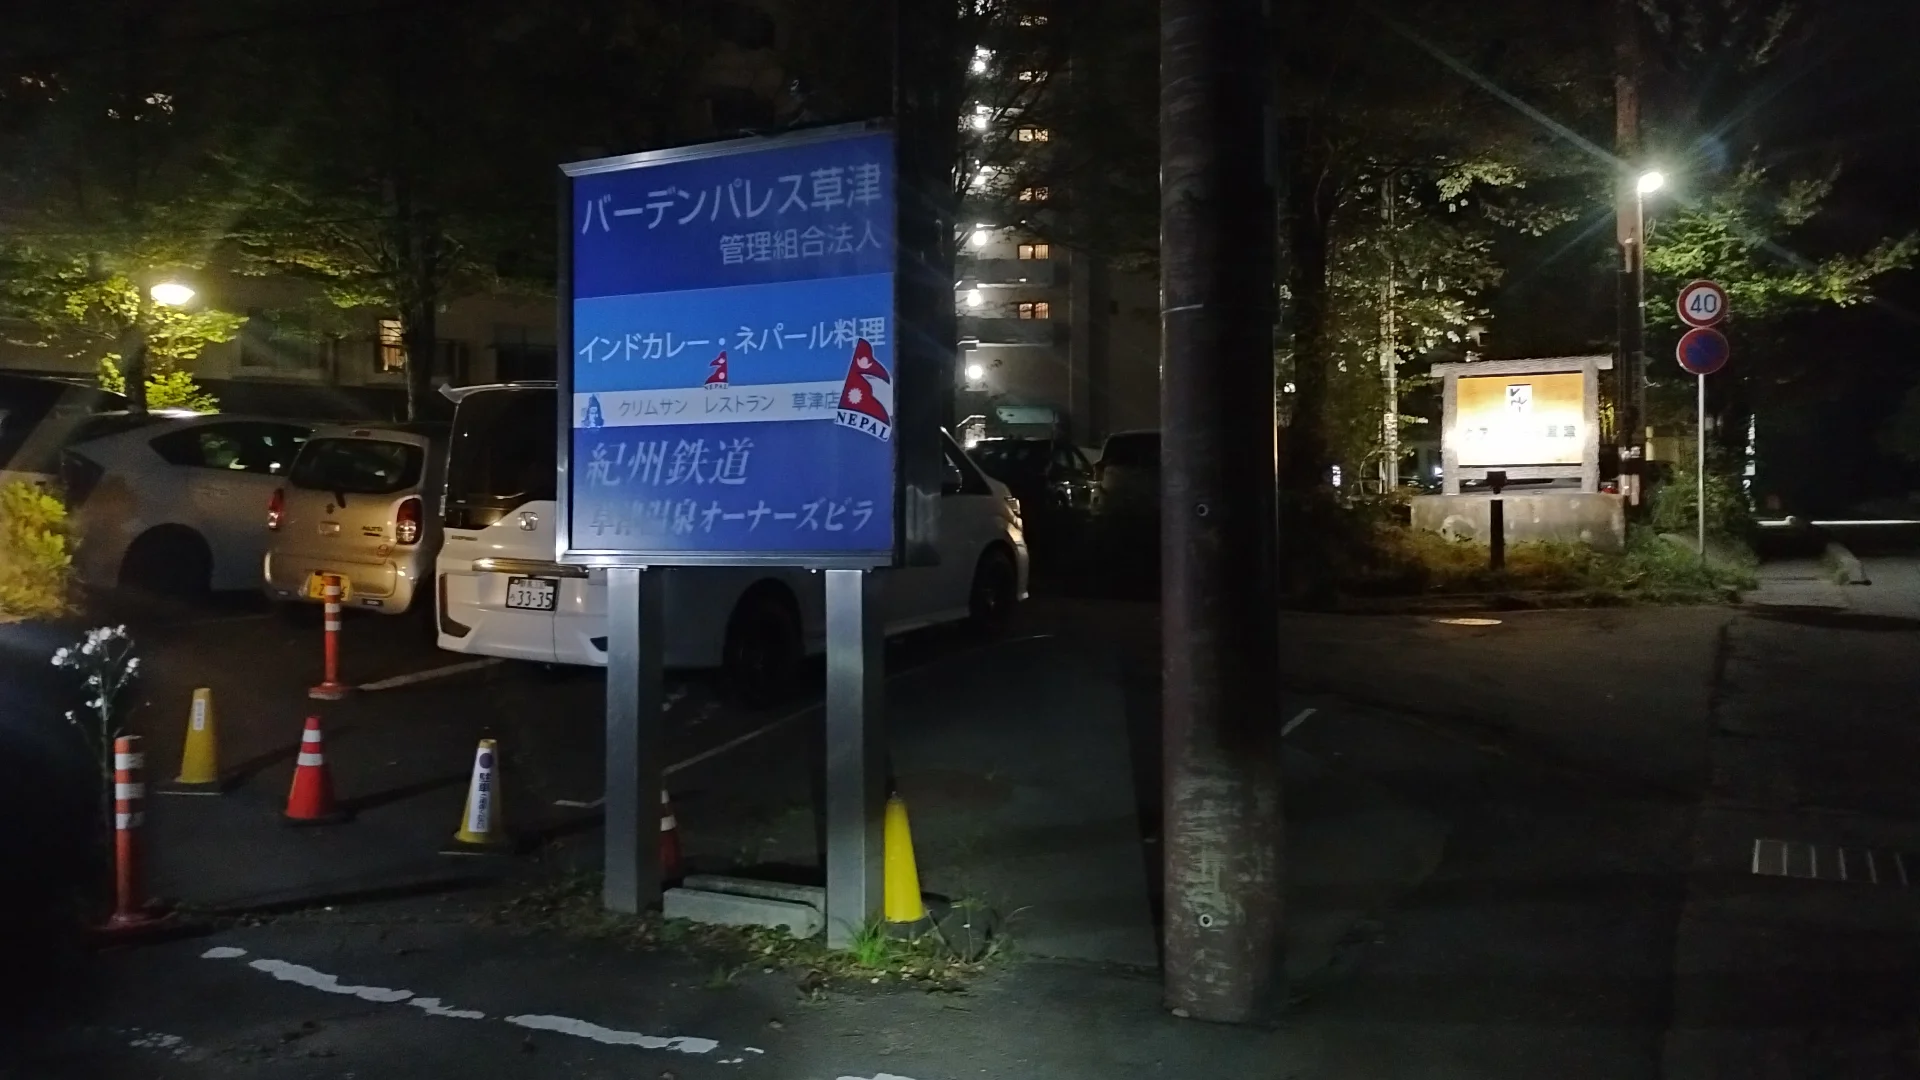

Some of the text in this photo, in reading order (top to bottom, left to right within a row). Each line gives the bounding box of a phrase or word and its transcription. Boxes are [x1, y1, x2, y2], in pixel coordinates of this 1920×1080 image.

[581, 163, 882, 235] バーデンパレス草津
[719, 219, 882, 266] 管理組合法人
[1690, 294, 1717, 314] 40
[579, 316, 886, 363] インドカレー・ネパール料理
[618, 389, 841, 417] クリムサン レストラン 草津店
[835, 411, 888, 441] NEPAL
[586, 436, 755, 489] 紀州鉄道
[588, 497, 873, 537] 草泉オーナーズビラ
